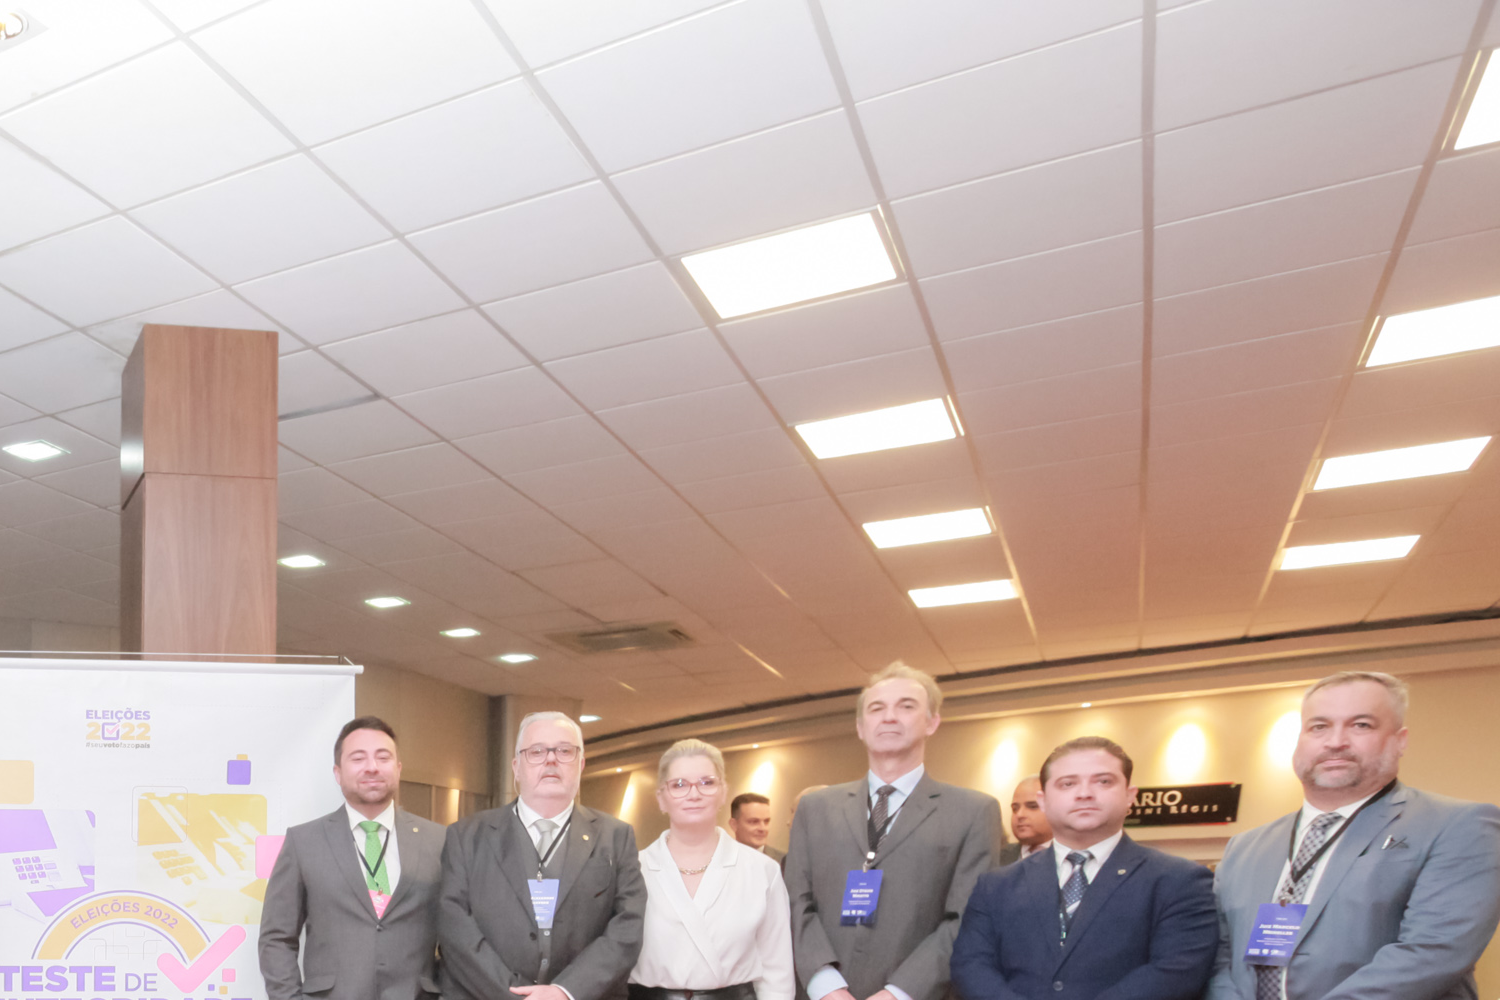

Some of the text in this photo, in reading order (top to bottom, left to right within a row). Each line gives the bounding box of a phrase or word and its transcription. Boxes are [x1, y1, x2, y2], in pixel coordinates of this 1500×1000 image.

[86, 707, 151, 722] ELEIÇÕES
[70, 899, 179, 929] ELEIÇÕES 2022
[125, 973, 158, 992] DE
